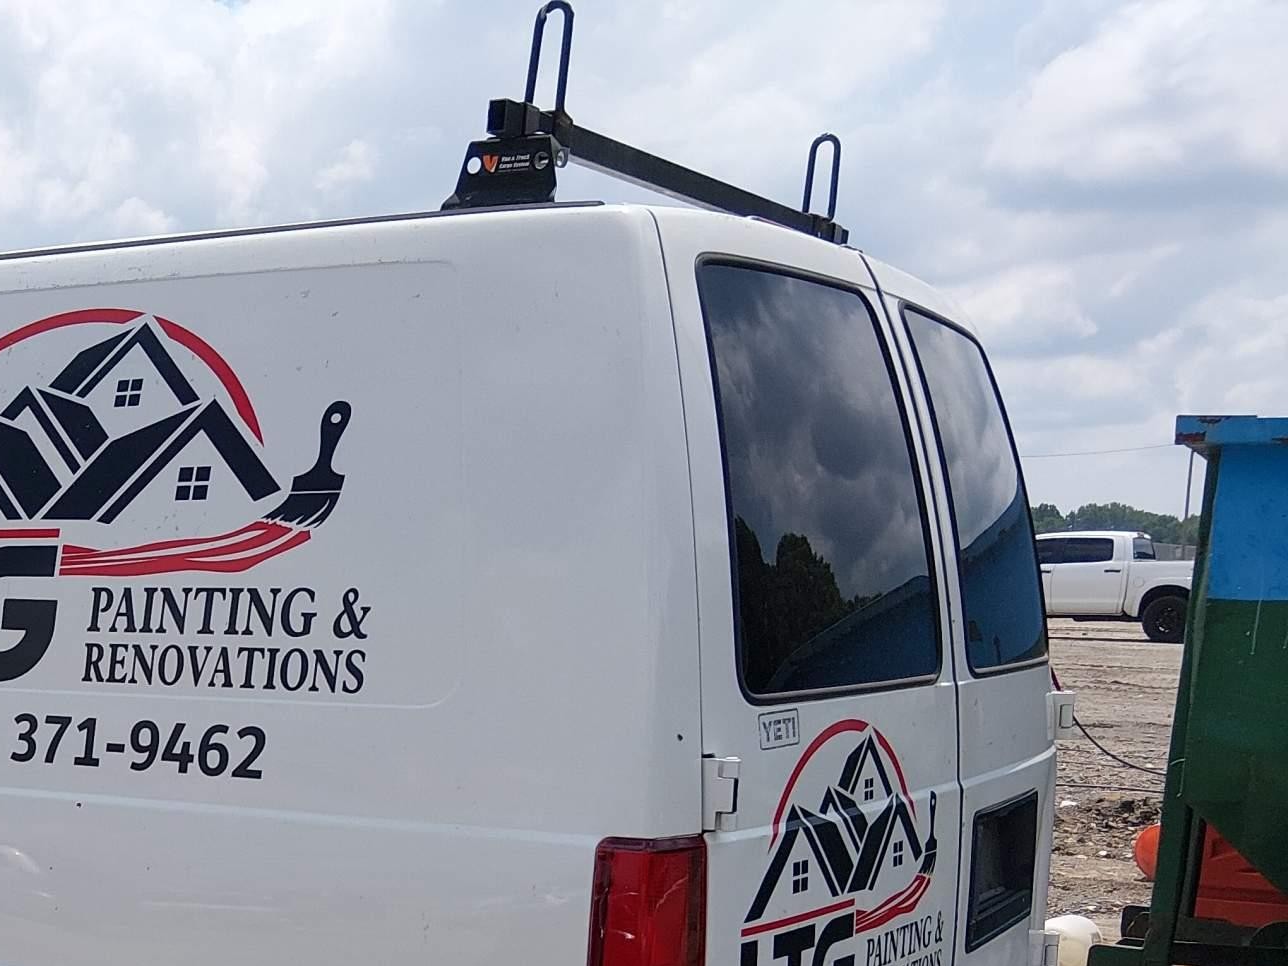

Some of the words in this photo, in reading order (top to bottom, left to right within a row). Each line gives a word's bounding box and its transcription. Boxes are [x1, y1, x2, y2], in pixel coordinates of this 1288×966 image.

[86, 586, 318, 640] PAINTING
[332, 587, 372, 640] &
[81, 642, 367, 695] RENOVATIONS
[10, 712, 266, 780] 371-9462
[762, 716, 797, 743] YETI
[934, 910, 945, 945] &
